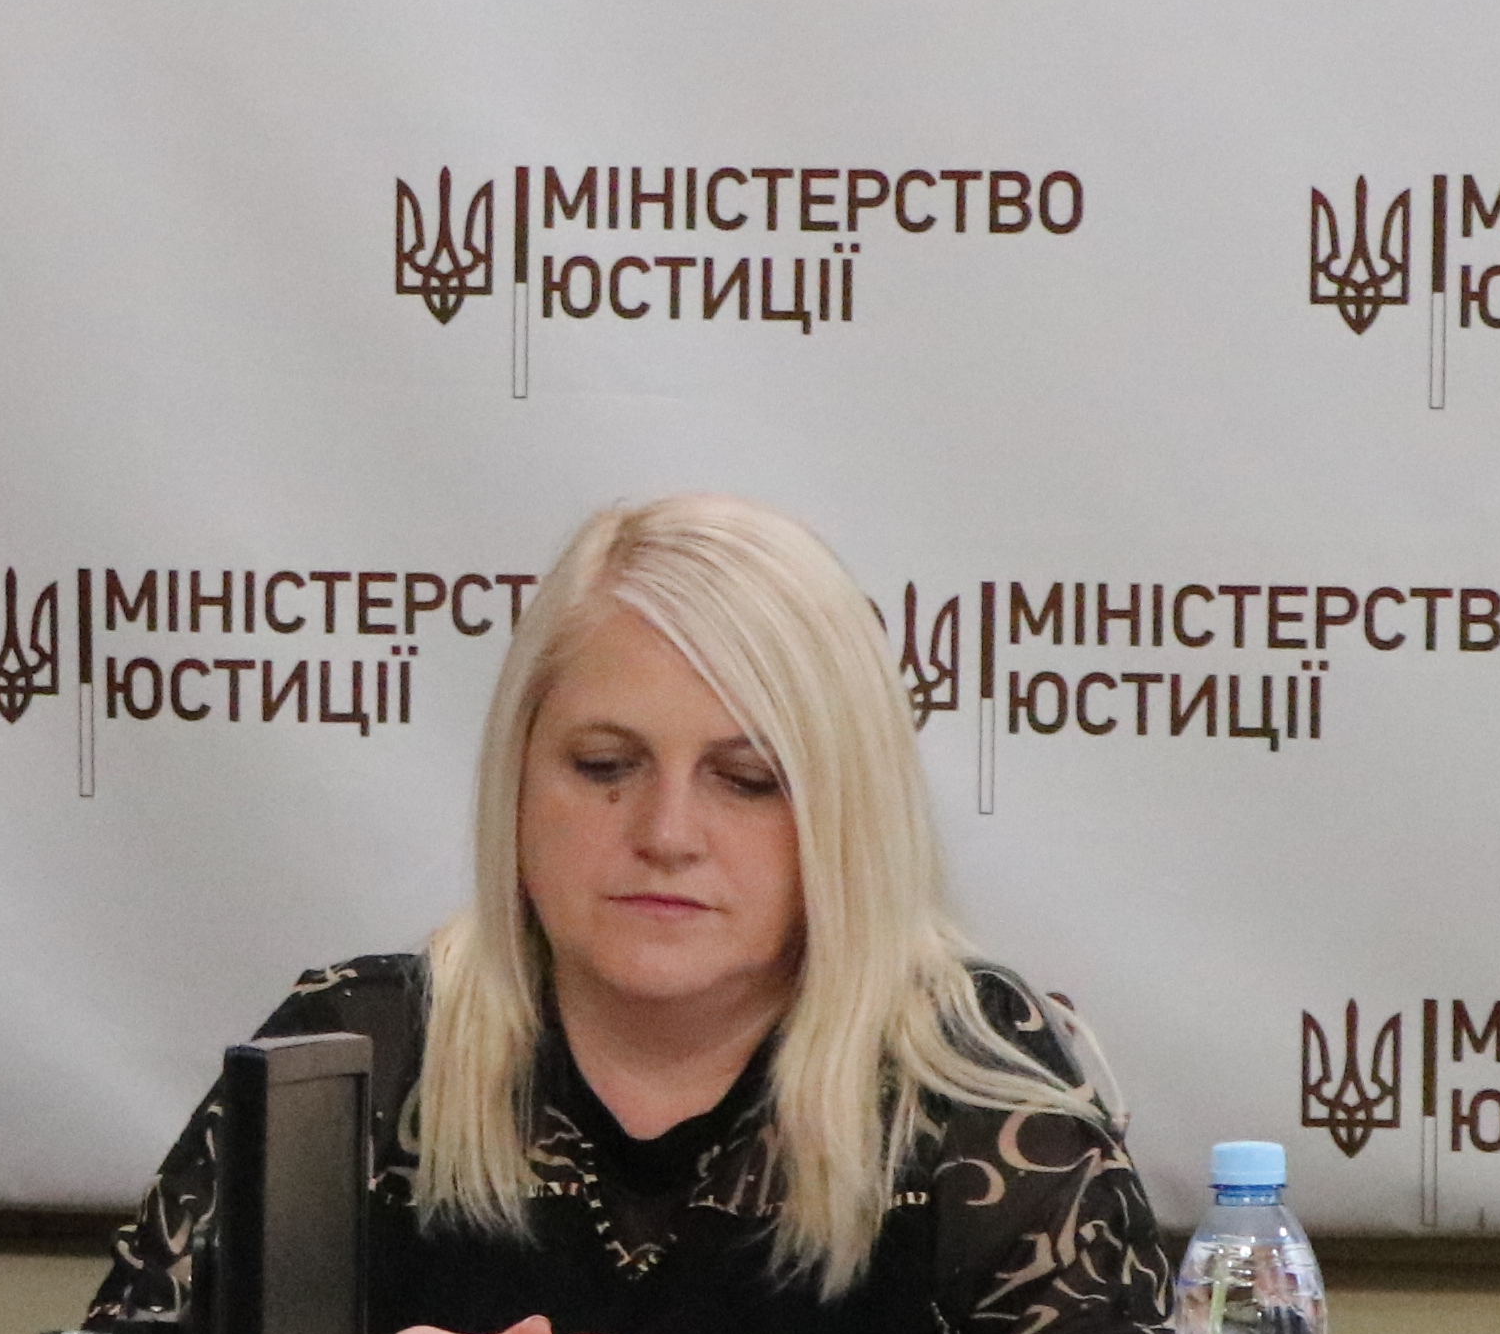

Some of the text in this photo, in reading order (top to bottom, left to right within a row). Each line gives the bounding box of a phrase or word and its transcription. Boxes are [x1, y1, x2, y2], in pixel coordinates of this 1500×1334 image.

[543, 165, 1084, 235] МІНІСТЕРСТВО
[541, 242, 861, 336] ЮСТИЦІЇ
[105, 569, 539, 636] МІНІСТЕРСТ
[105, 645, 419, 737] ЮСТИЦІЇ
[1008, 659, 1329, 753] ЮСТИЦІЇ
